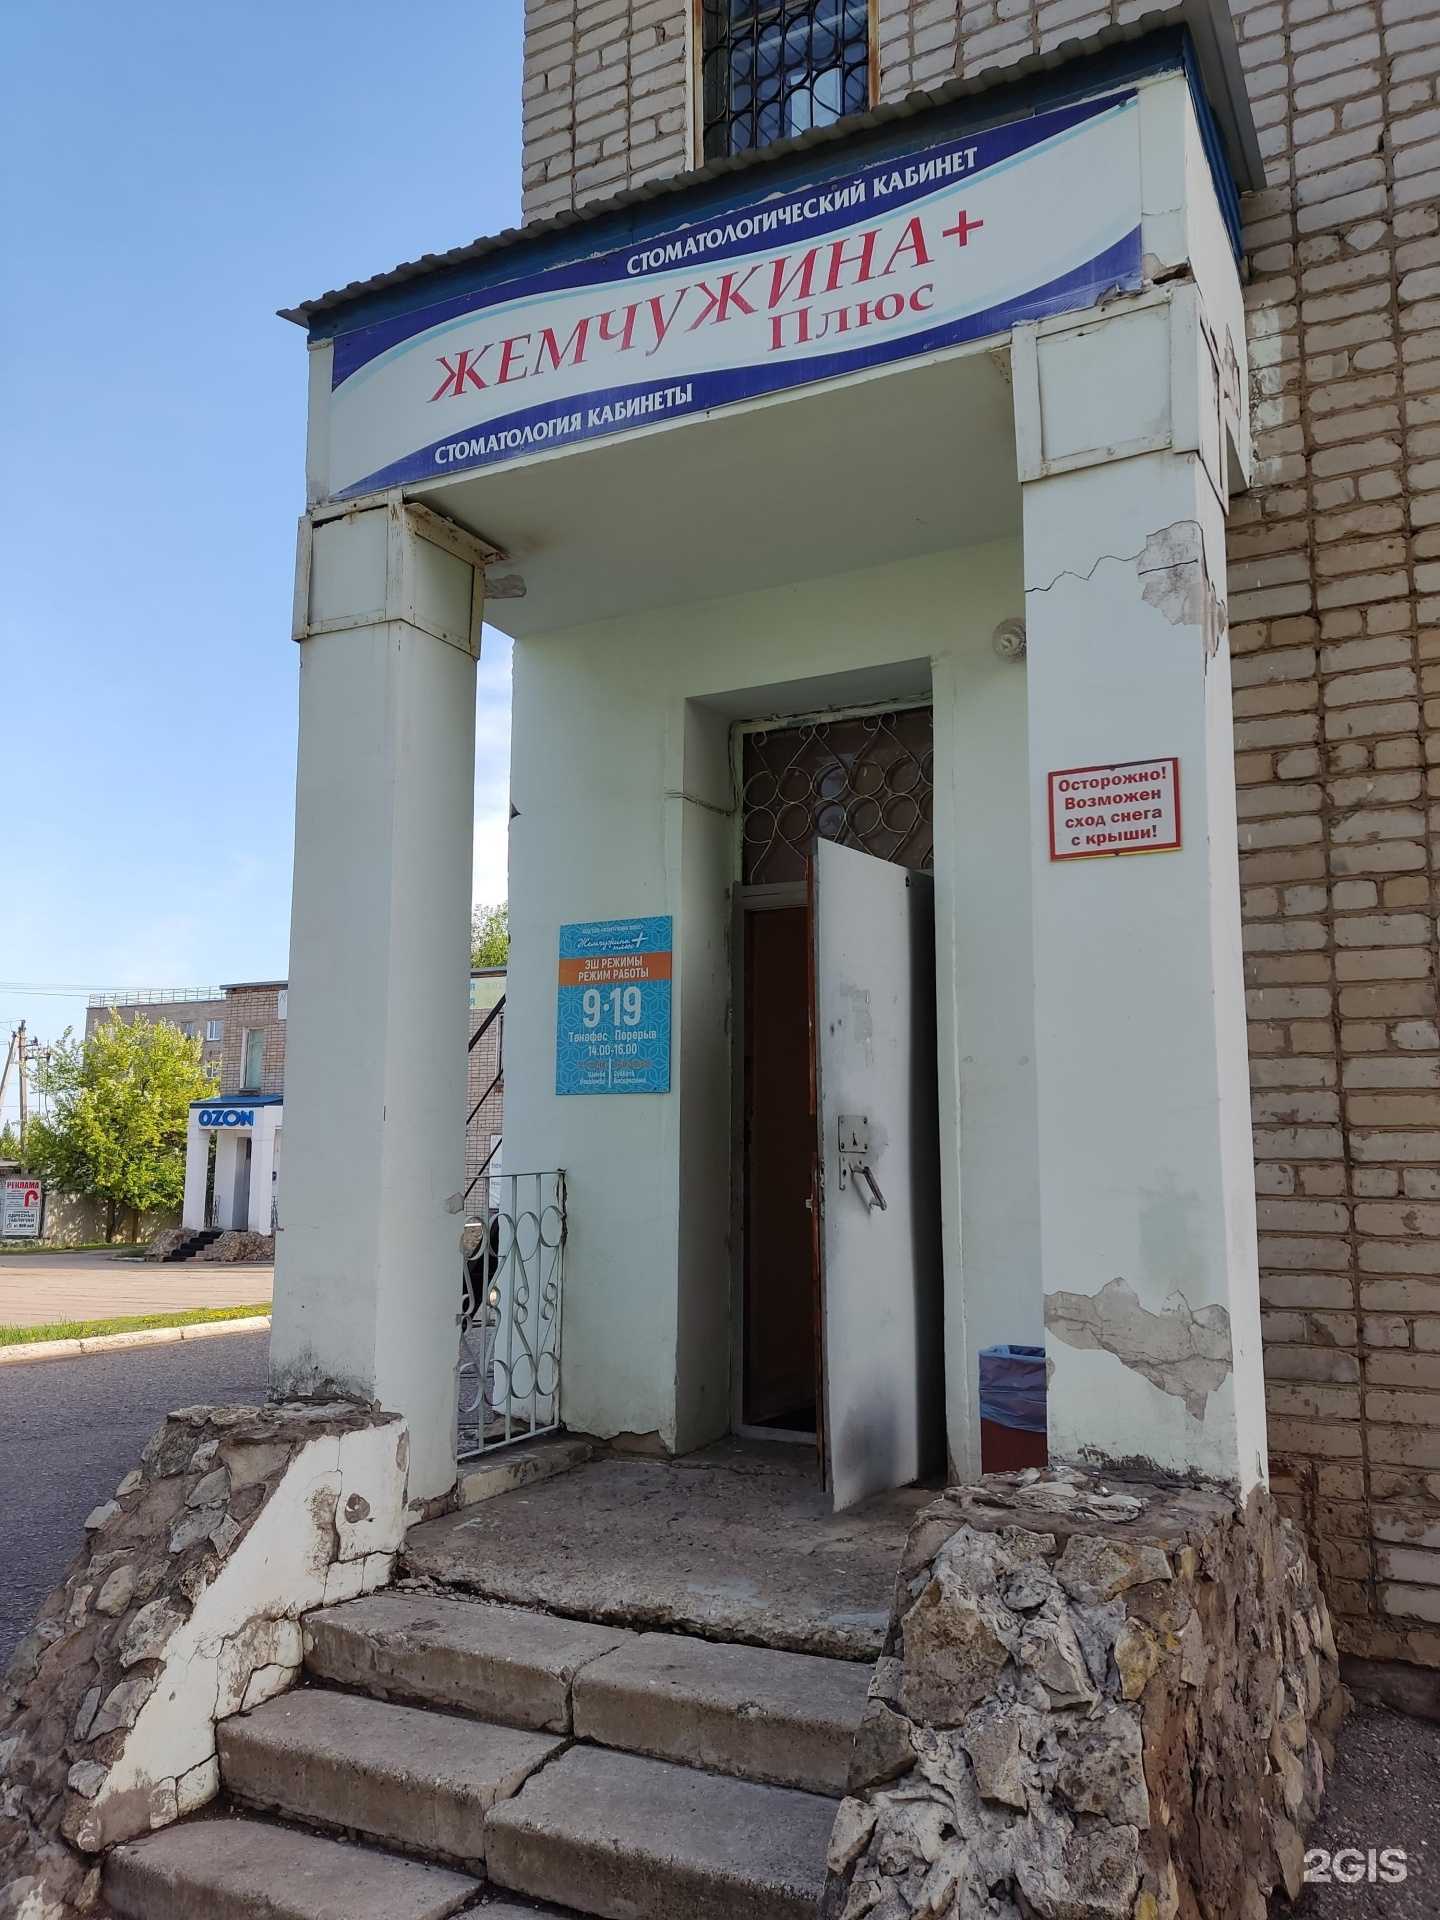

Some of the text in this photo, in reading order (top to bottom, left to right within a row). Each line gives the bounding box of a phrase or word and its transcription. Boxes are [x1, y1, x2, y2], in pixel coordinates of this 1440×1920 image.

[626, 147, 978, 276] СТОМАТОЛОГИЧЕСКИЙ КАБИНЕТ
[768, 283, 934, 352] Плюс
[435, 382, 693, 465] СТОМАТОЛОГИЯ КАБИНЕТЫ
[1058, 766, 1167, 792] Осторожно!
[1064, 788, 1162, 810] Возможен
[1065, 807, 1162, 829] сход снега
[1071, 824, 1157, 847] с крыши!
[584, 955, 643, 970] ЭШ РЕЖИМЫ
[578, 967, 649, 982] РЕЖИМ РАБОТЫ
[198, 1109, 254, 1126] OZON
[6, 1181, 39, 1189] РЕКЛАМА
